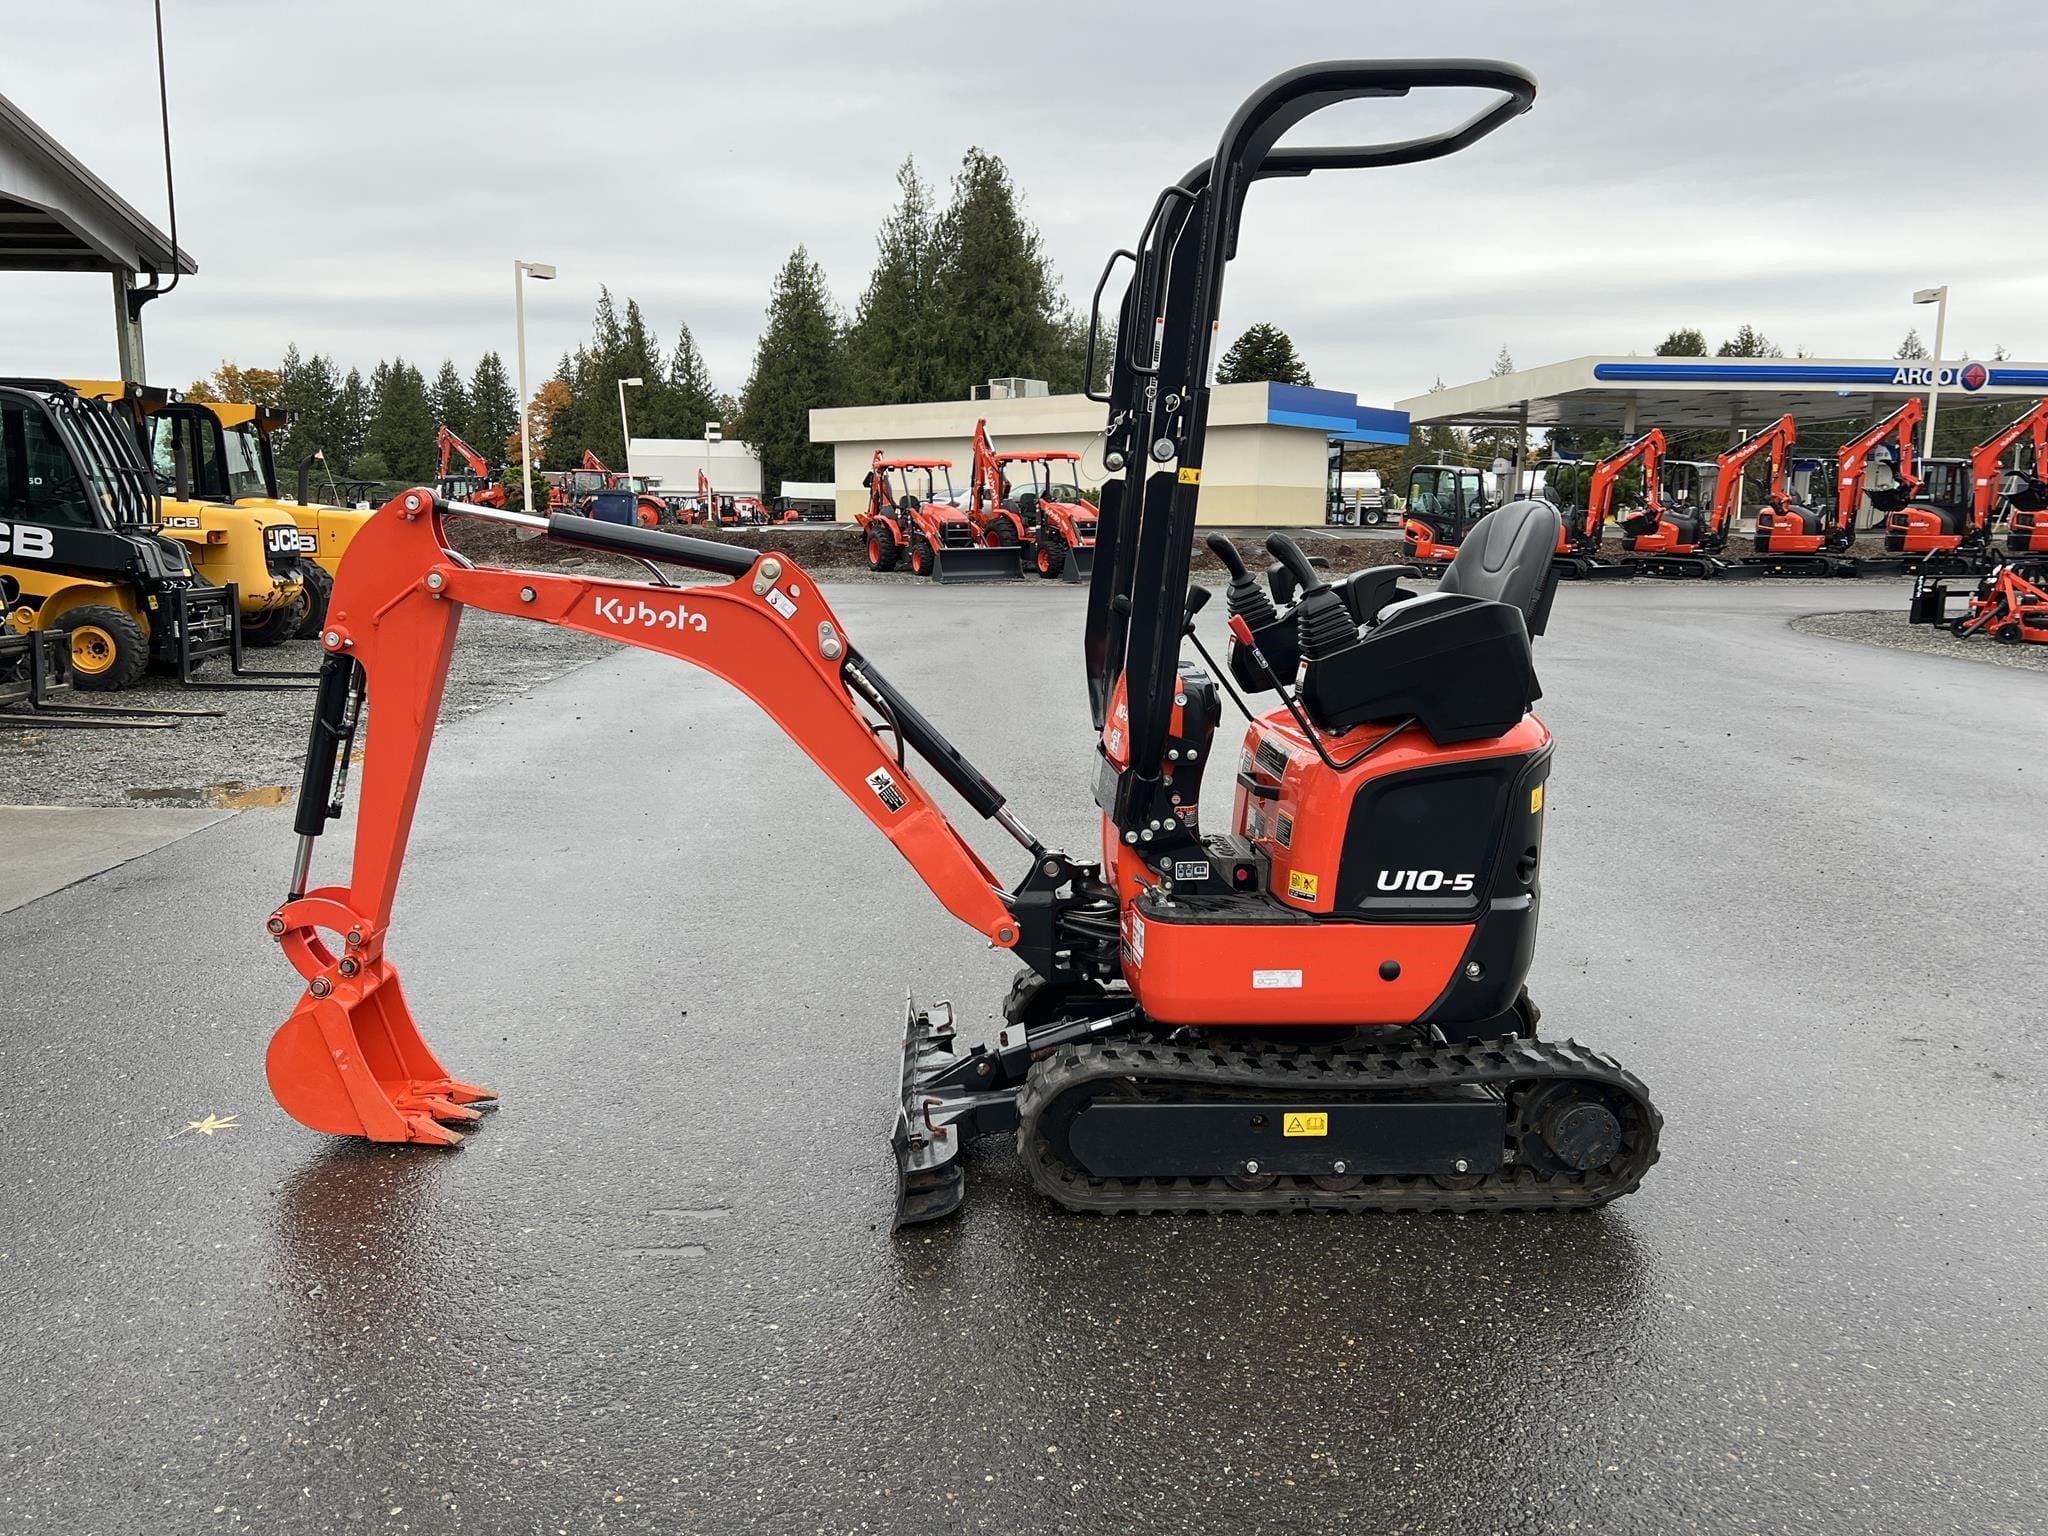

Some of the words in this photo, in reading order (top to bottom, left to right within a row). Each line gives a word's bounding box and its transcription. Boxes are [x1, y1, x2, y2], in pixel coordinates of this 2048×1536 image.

[1892, 367, 1953, 386] ARCO
[162, 517, 199, 529] JCB
[268, 529, 300, 552] JCB
[595, 596, 708, 632] Kubota
[1377, 870, 1476, 891] U10-5
